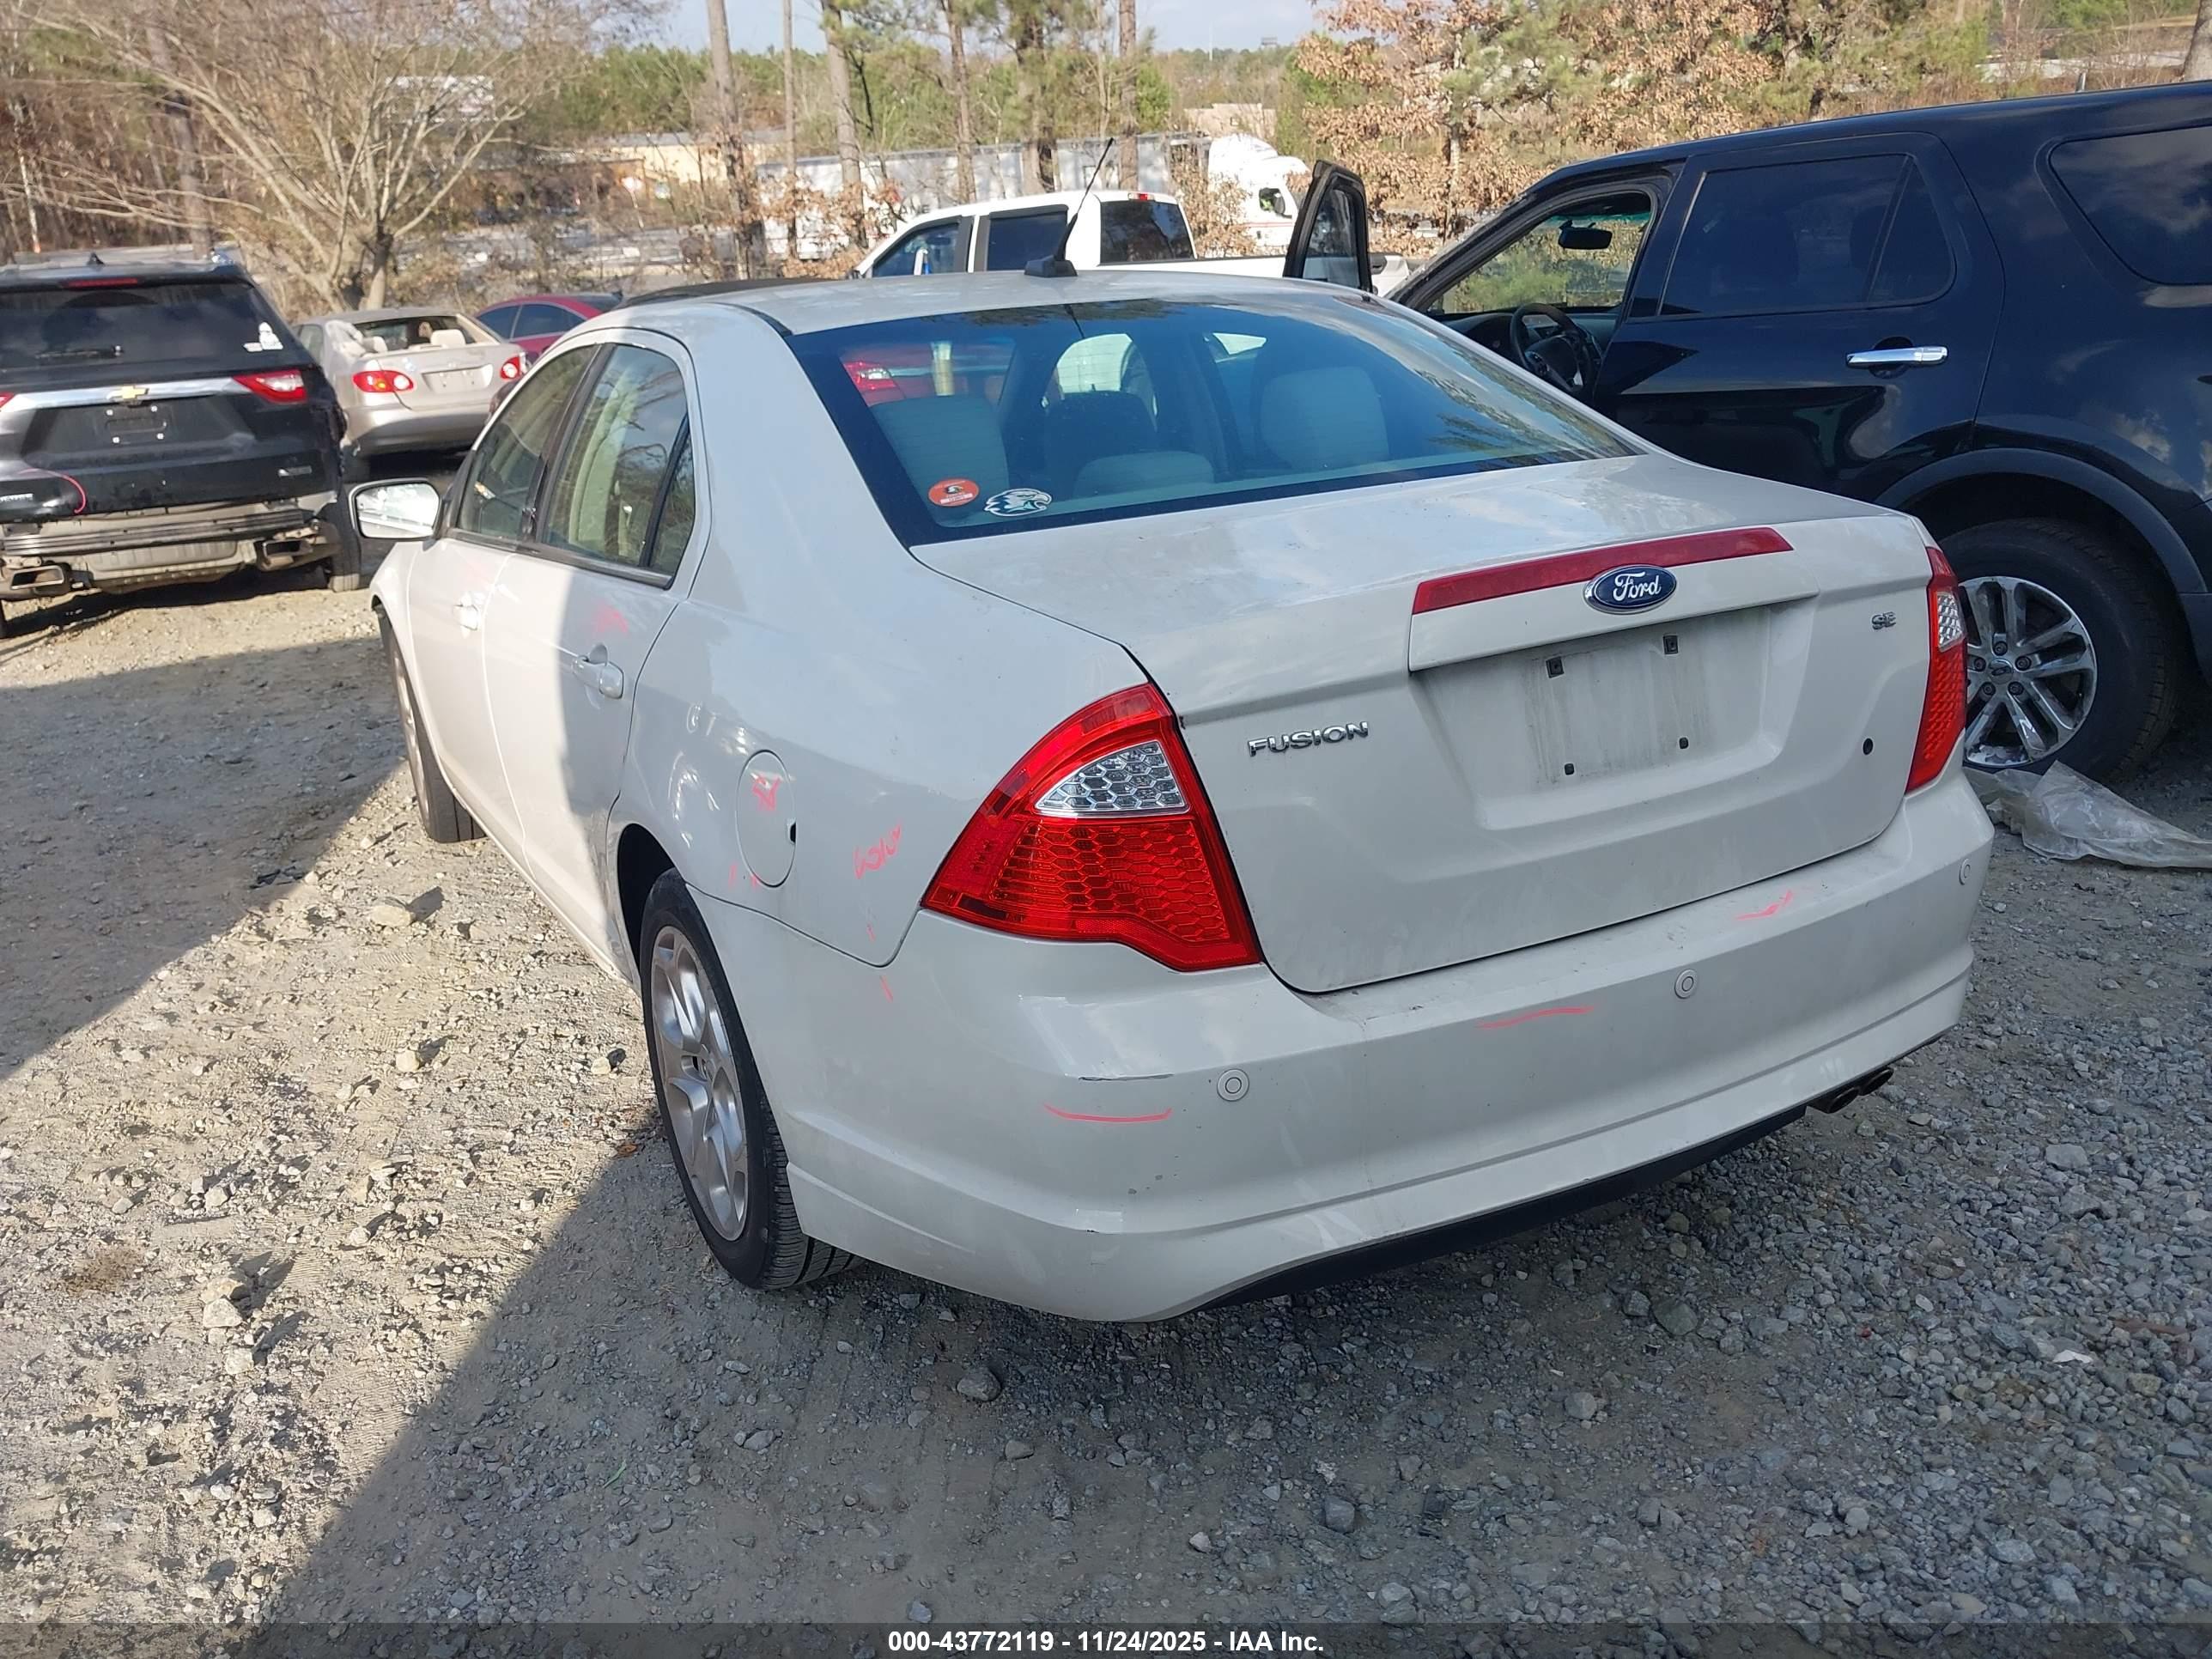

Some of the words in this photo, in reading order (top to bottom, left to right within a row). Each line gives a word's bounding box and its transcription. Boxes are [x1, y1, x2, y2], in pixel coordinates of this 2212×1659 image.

[1613, 571, 1662, 601] Ford
[1871, 611, 1896, 630] SE
[1248, 721, 1369, 757] FUSION
